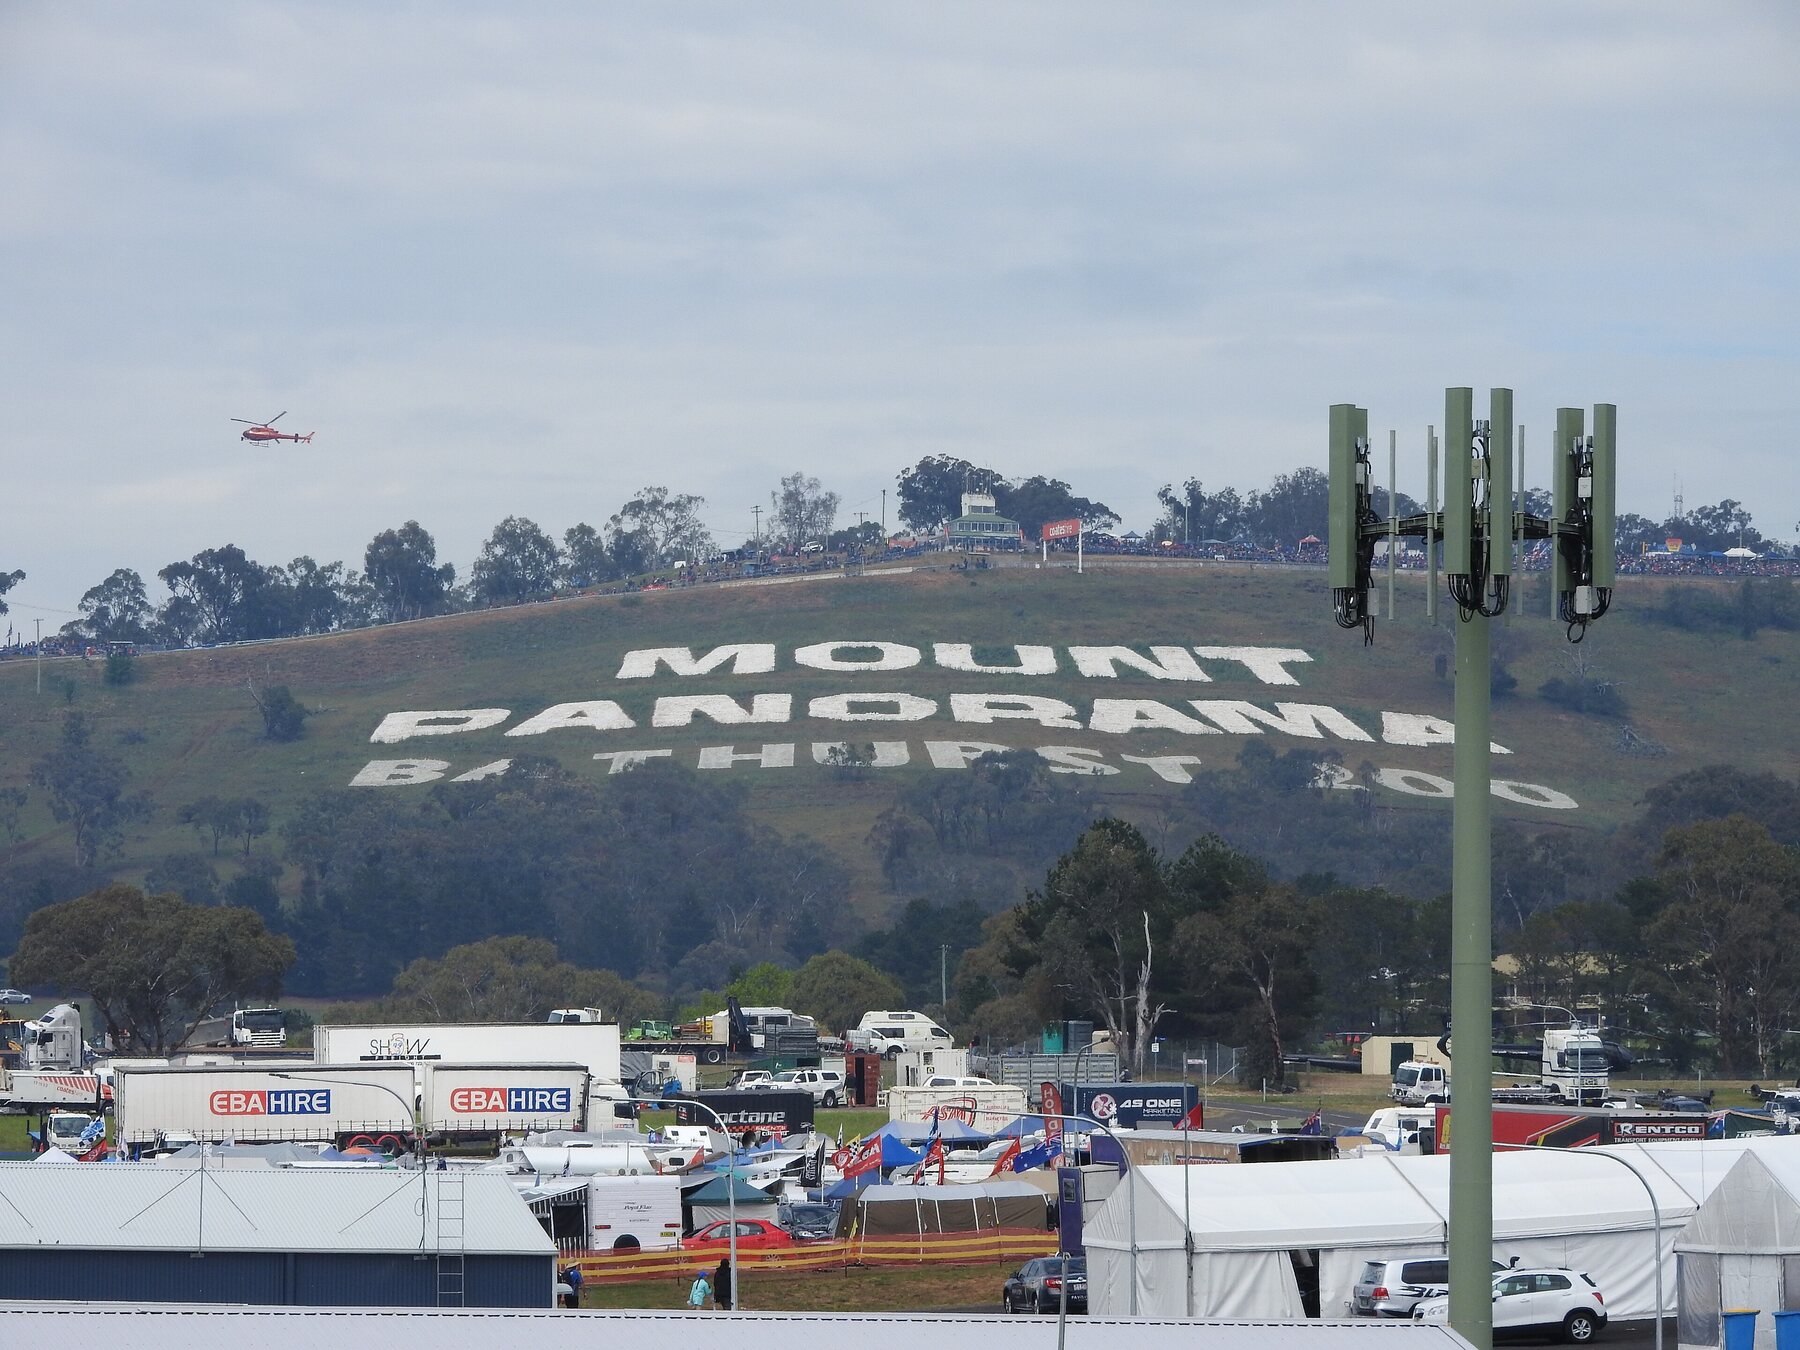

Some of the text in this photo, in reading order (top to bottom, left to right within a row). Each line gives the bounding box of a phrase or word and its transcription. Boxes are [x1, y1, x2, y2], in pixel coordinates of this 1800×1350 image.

[615, 641, 1314, 687] MOUNT
[370, 693, 1513, 754] PANORAMA
[213, 1092, 327, 1113] EBA HIRE
[453, 1090, 567, 1110] EBA HIRE
[1119, 1099, 1182, 1108] AS ONE
[1617, 1122, 1701, 1136] RENTCO
